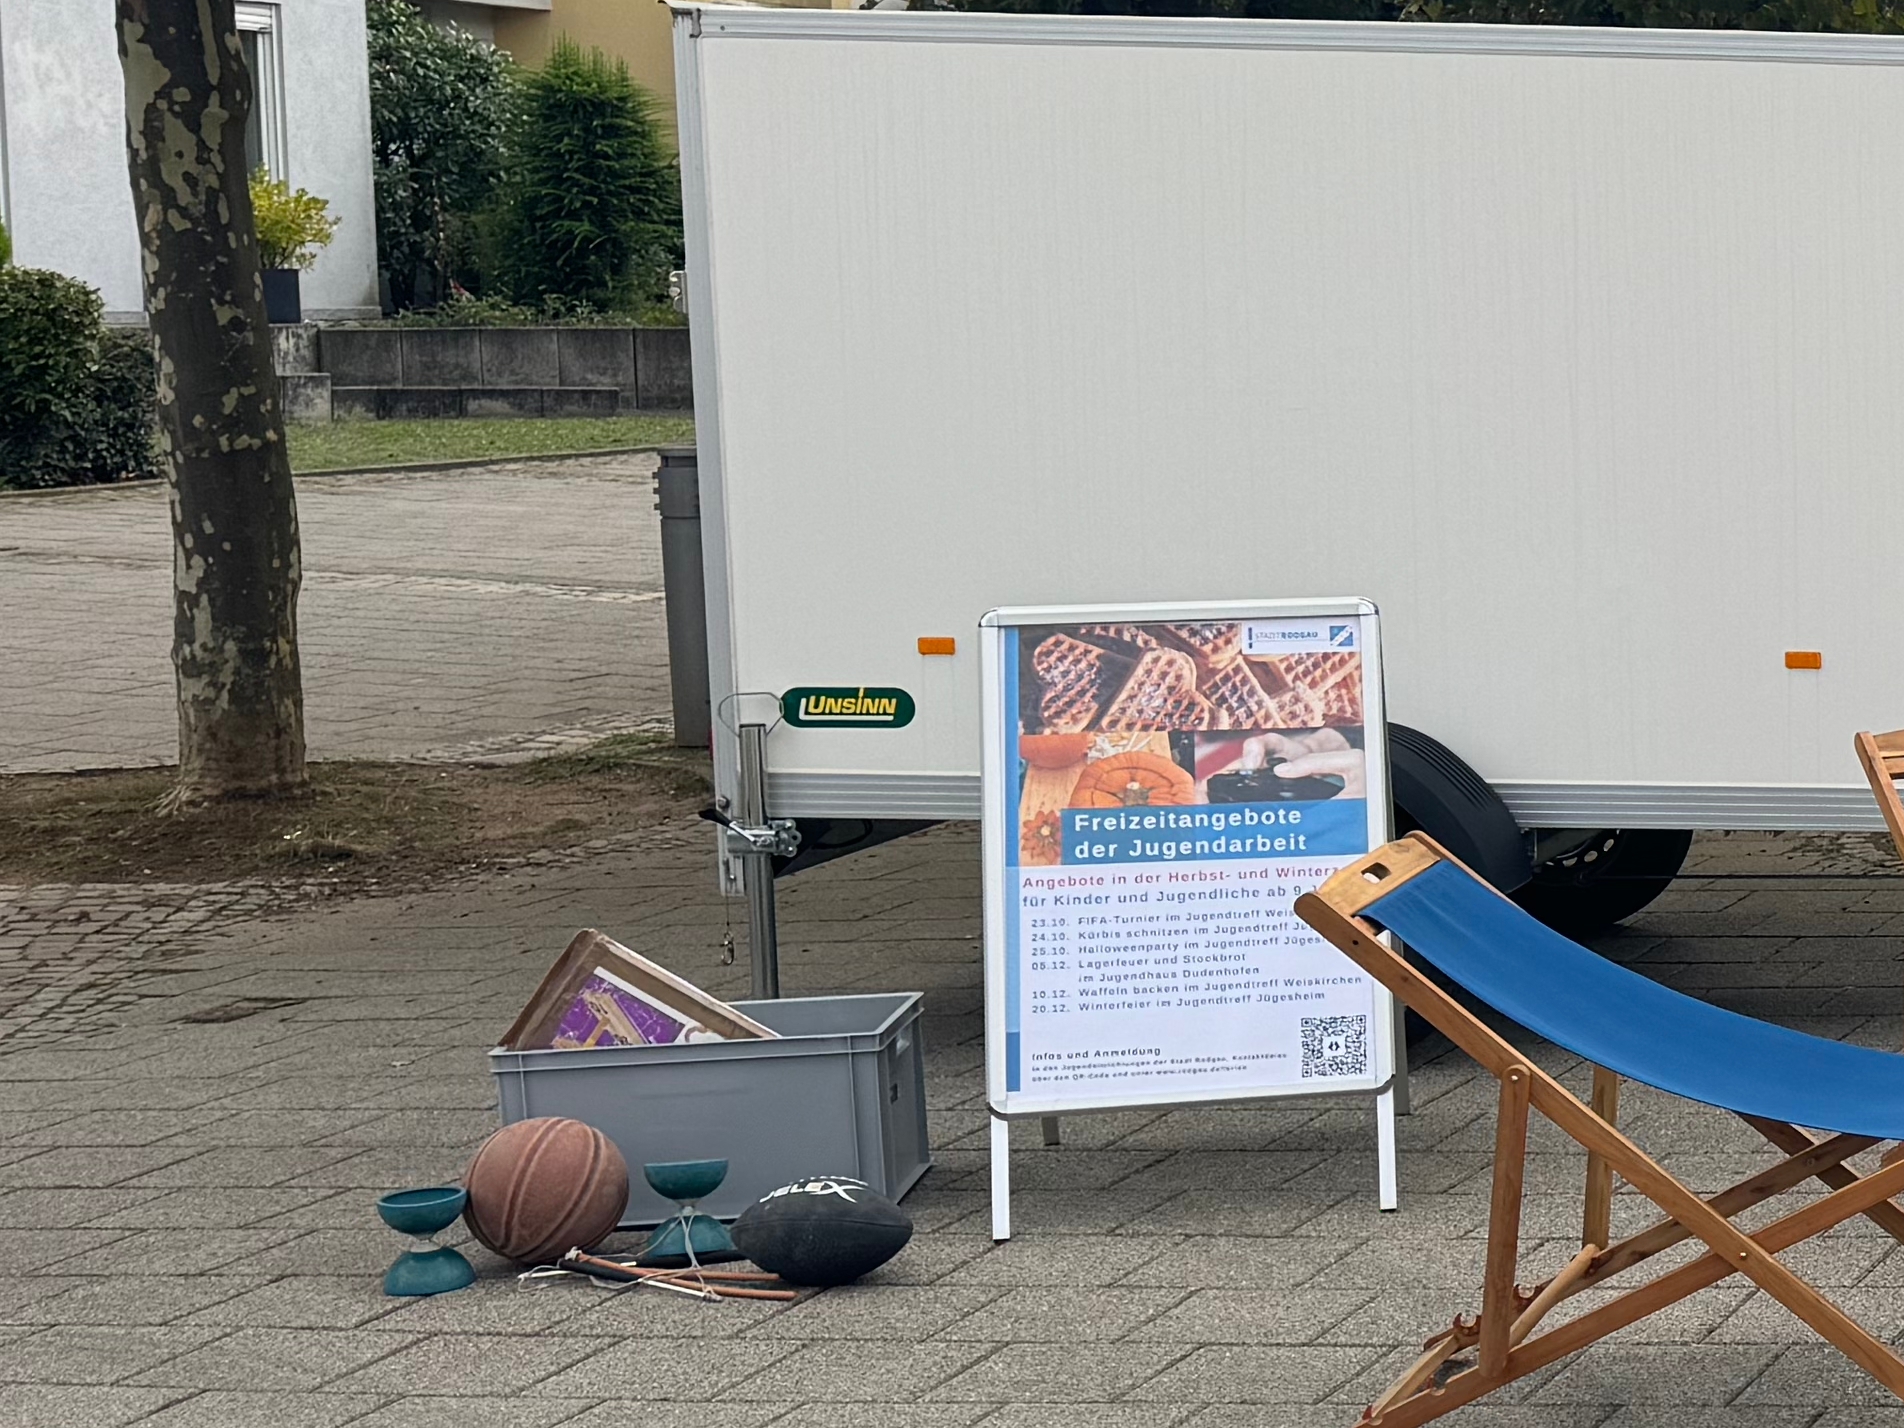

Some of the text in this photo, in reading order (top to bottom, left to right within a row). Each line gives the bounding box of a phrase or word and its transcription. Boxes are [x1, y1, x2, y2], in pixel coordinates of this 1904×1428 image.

[1074, 808, 1302, 831] Freizeitangebote
[1074, 834, 1307, 860] der Jugendarbeit
[1022, 875, 1105, 890] Angebote
[1112, 873, 1127, 884] in
[1134, 872, 1161, 884] der
[1168, 870, 1231, 883] Herbst-
[1238, 868, 1269, 880] und
[1022, 895, 1047, 907] für
[1054, 893, 1111, 906] Kinder
[1117, 891, 1149, 904] und
[1156, 887, 1260, 904] Jugendliche
[1266, 886, 1286, 897] ab
[1031, 917, 1070, 928] 23.10.
[1078, 914, 1160, 925] FIFA-Turnier
[1166, 913, 1181, 922] im
[1185, 910, 1260, 922] Jugendtreff
[1031, 932, 1070, 942] 24.10.
[1078, 929, 1121, 940] Kürbis
[1126, 927, 1189, 938] schnitzen
[1194, 926, 1209, 935] im
[1213, 922, 1288, 935] Jugendtreff
[1031, 946, 1070, 956] 25.10.
[1078, 942, 1179, 954] Halloweenparty
[1184, 940, 1199, 949] im
[1204, 937, 1279, 949] Jugendtreff
[1031, 953, 1246, 970] 05.12. Lagerfeuer und Stockbrot
[1078, 967, 1260, 983] im Jugendhaus Dudenhofen
[1032, 976, 1362, 999] 10.12. Waffeln backen im Jugendtreff Weiskirchen
[1031, 991, 1325, 1013] 20.12. Winterfeier im Jugendtreff Jügesheim
[1031, 1047, 1161, 1061] Infos und Anmeldung
